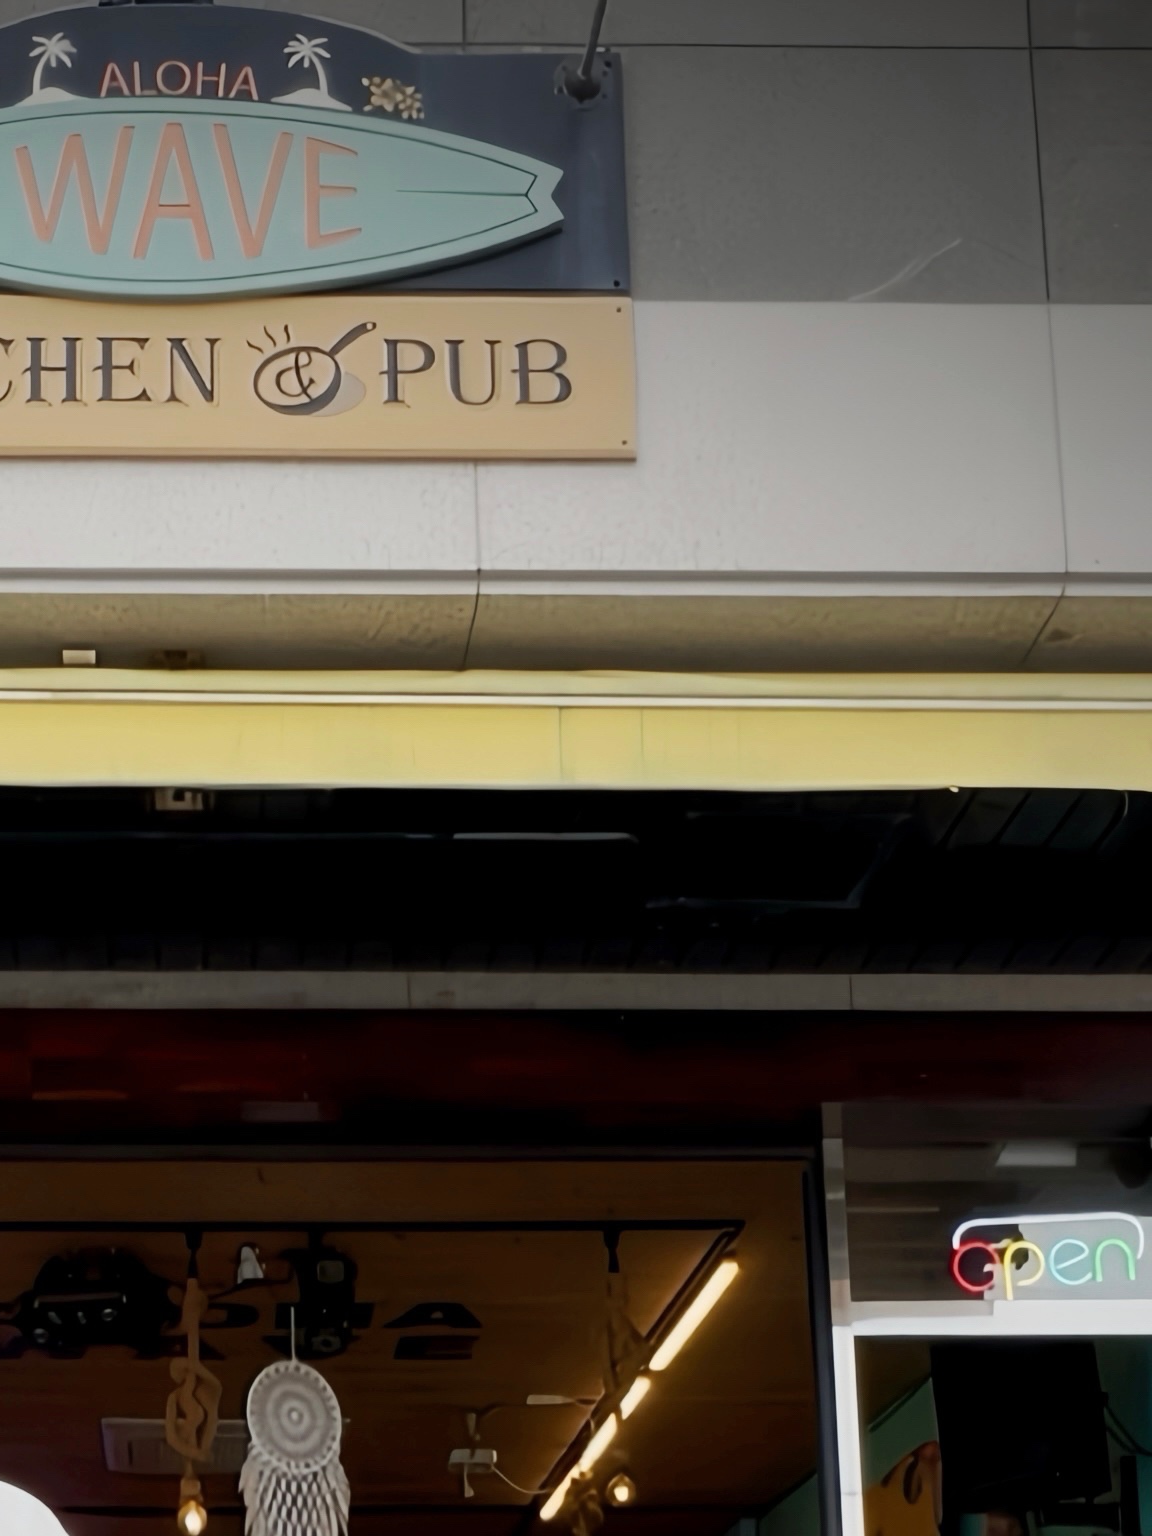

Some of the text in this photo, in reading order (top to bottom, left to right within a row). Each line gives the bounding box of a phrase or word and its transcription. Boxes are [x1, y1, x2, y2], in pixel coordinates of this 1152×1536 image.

[99, 60, 259, 101] ALOHA
[15, 122, 363, 261] WAVE
[275, 350, 316, 400] &
[379, 338, 573, 406] PUB
